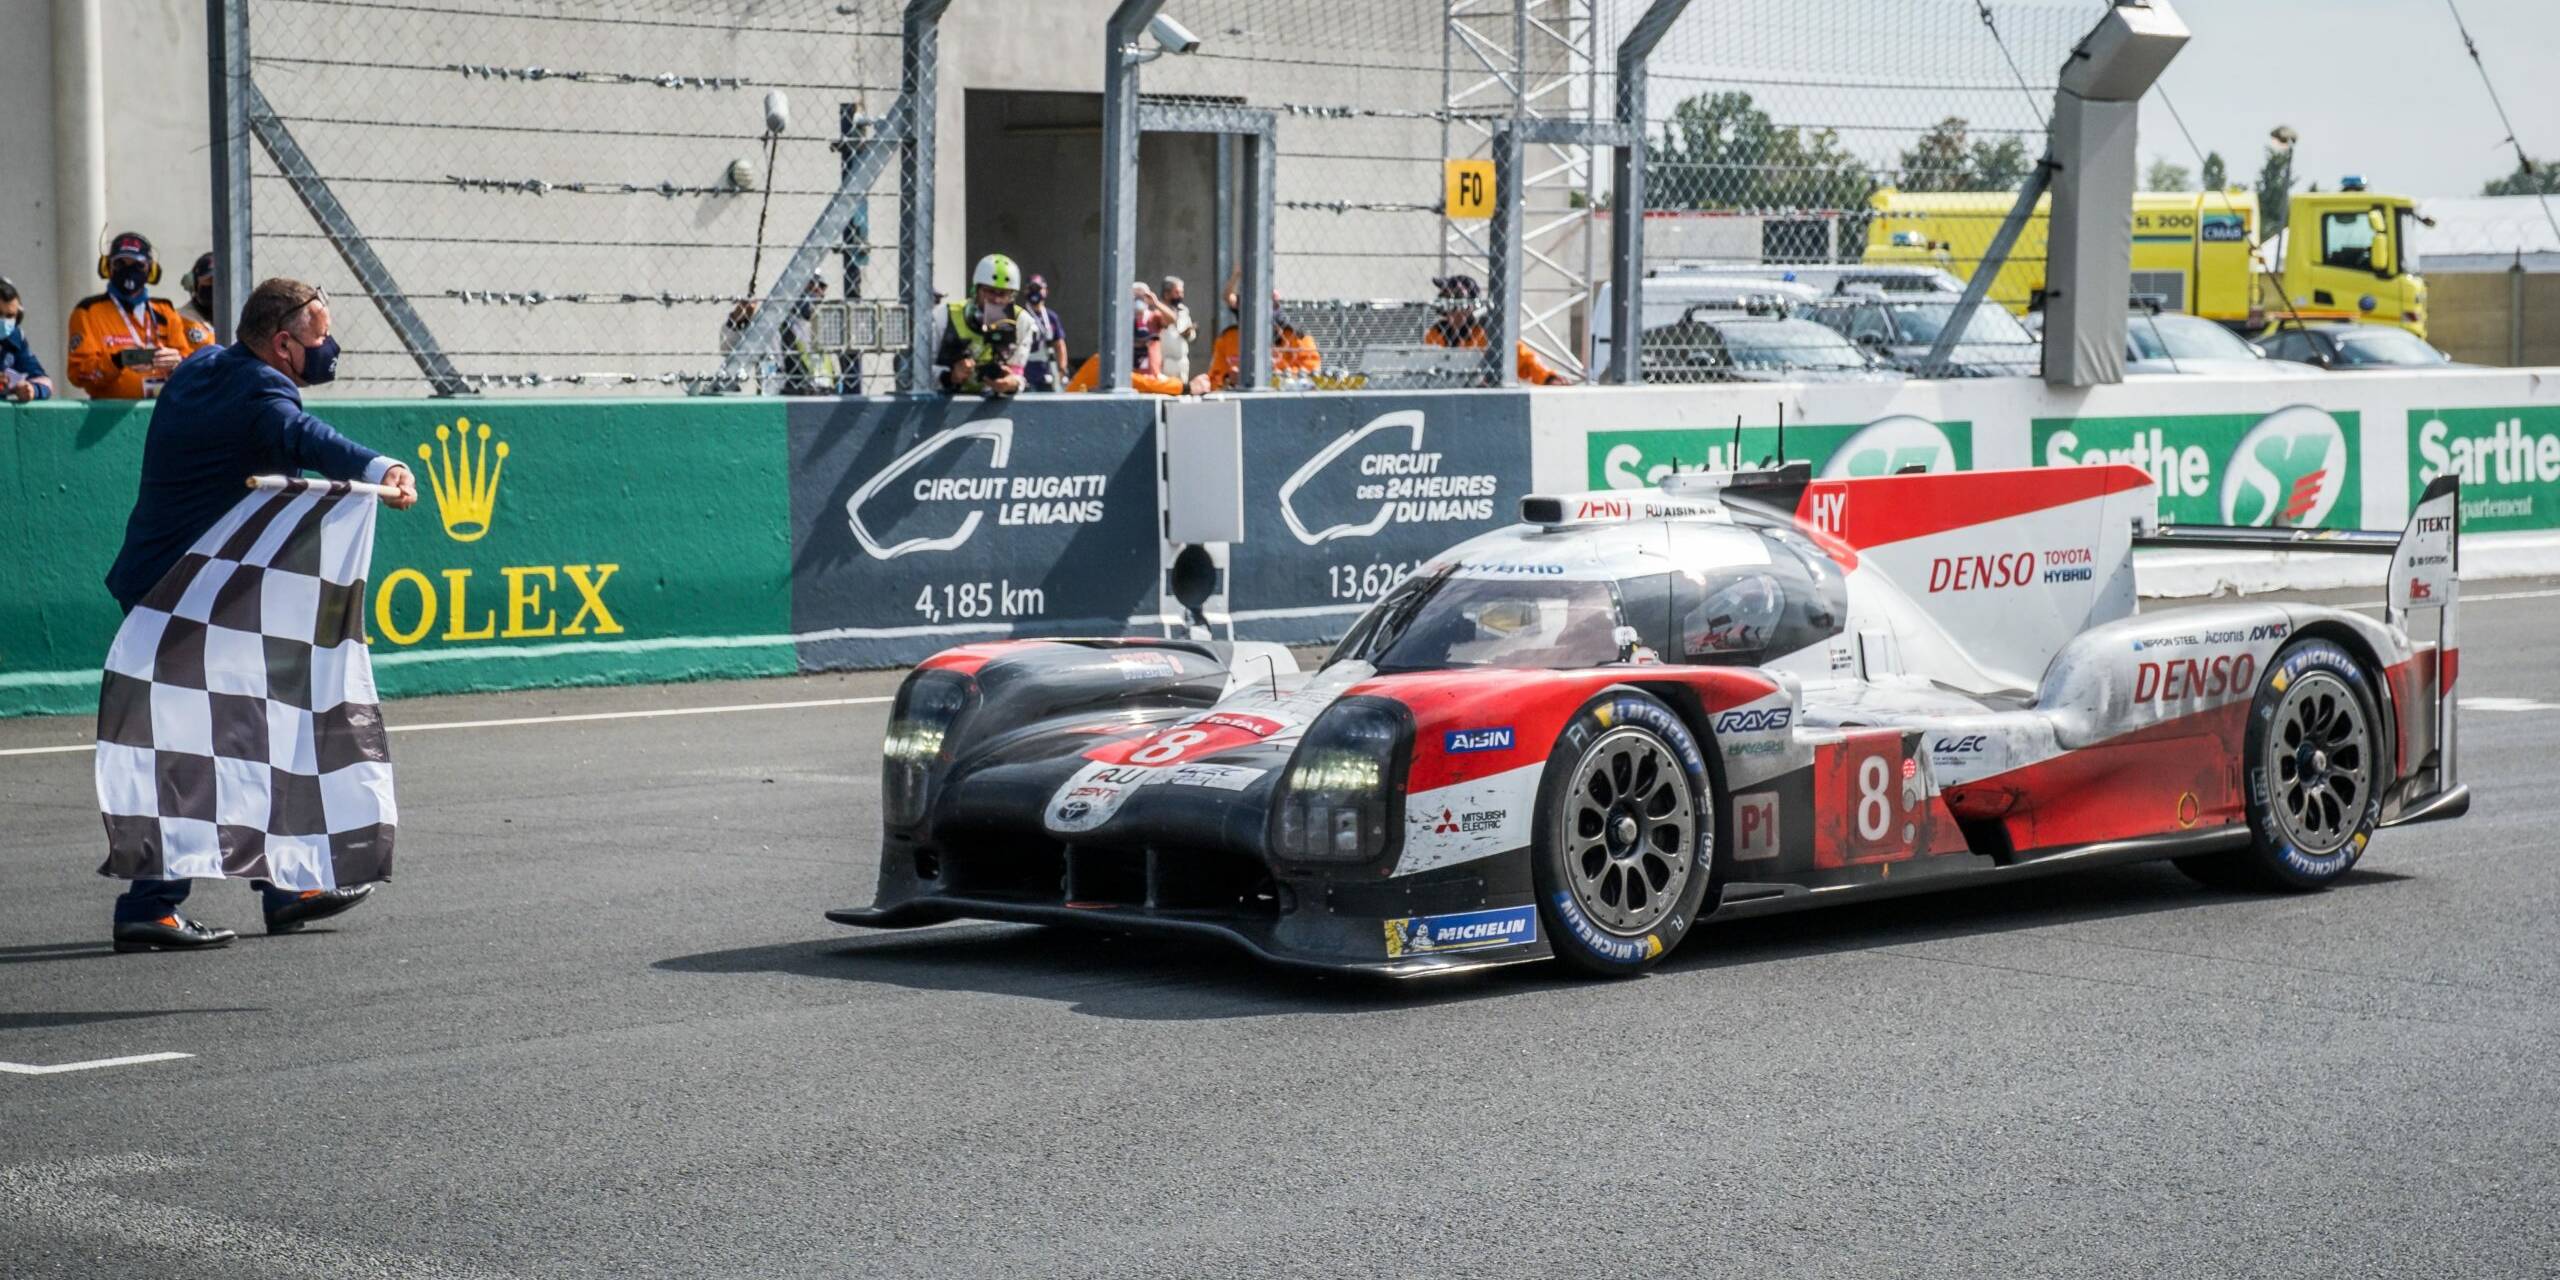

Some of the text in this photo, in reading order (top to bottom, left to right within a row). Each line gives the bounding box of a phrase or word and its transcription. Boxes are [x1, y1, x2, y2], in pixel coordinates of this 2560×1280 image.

[2159, 215, 2193, 228] 200
[1361, 453, 1442, 476] CIRCUIT
[2419, 418, 2560, 485] Sarthe
[913, 475, 1106, 501] CIRCUIT BUGATTI
[1357, 484, 1383, 499] DES
[1664, 505, 1696, 516] AISIN
[1813, 492, 1846, 533] HY
[2416, 516, 2451, 536] JTEKT
[2044, 549, 2092, 565] TOYOTA
[1329, 563, 1406, 602] 13,626
[1928, 552, 2035, 593] DENSO
[2044, 568, 2092, 583] HYBRID
[364, 563, 625, 646] OLEX
[914, 580, 1044, 623] 4,185 km
[2143, 635, 2199, 648] NIPPON STEEL
[2205, 630, 2245, 644] Acronis
[2296, 650, 2358, 678] MICHELIN
[2133, 653, 2255, 704] DENSO
[1716, 707, 1792, 734] RAYS
[1130, 730, 1207, 763] 8
[1629, 703, 1699, 765] MICHELIN
[1934, 735, 1987, 752] WEC
[1858, 755, 1891, 841] 8
[1462, 810, 1506, 822] MITSUBISHI
[1462, 820, 1501, 832] ELECTRIC
[1741, 802, 1774, 850] P1
[1437, 918, 1526, 941] MICHELIN
[1561, 899, 1634, 960] MICHELIN
